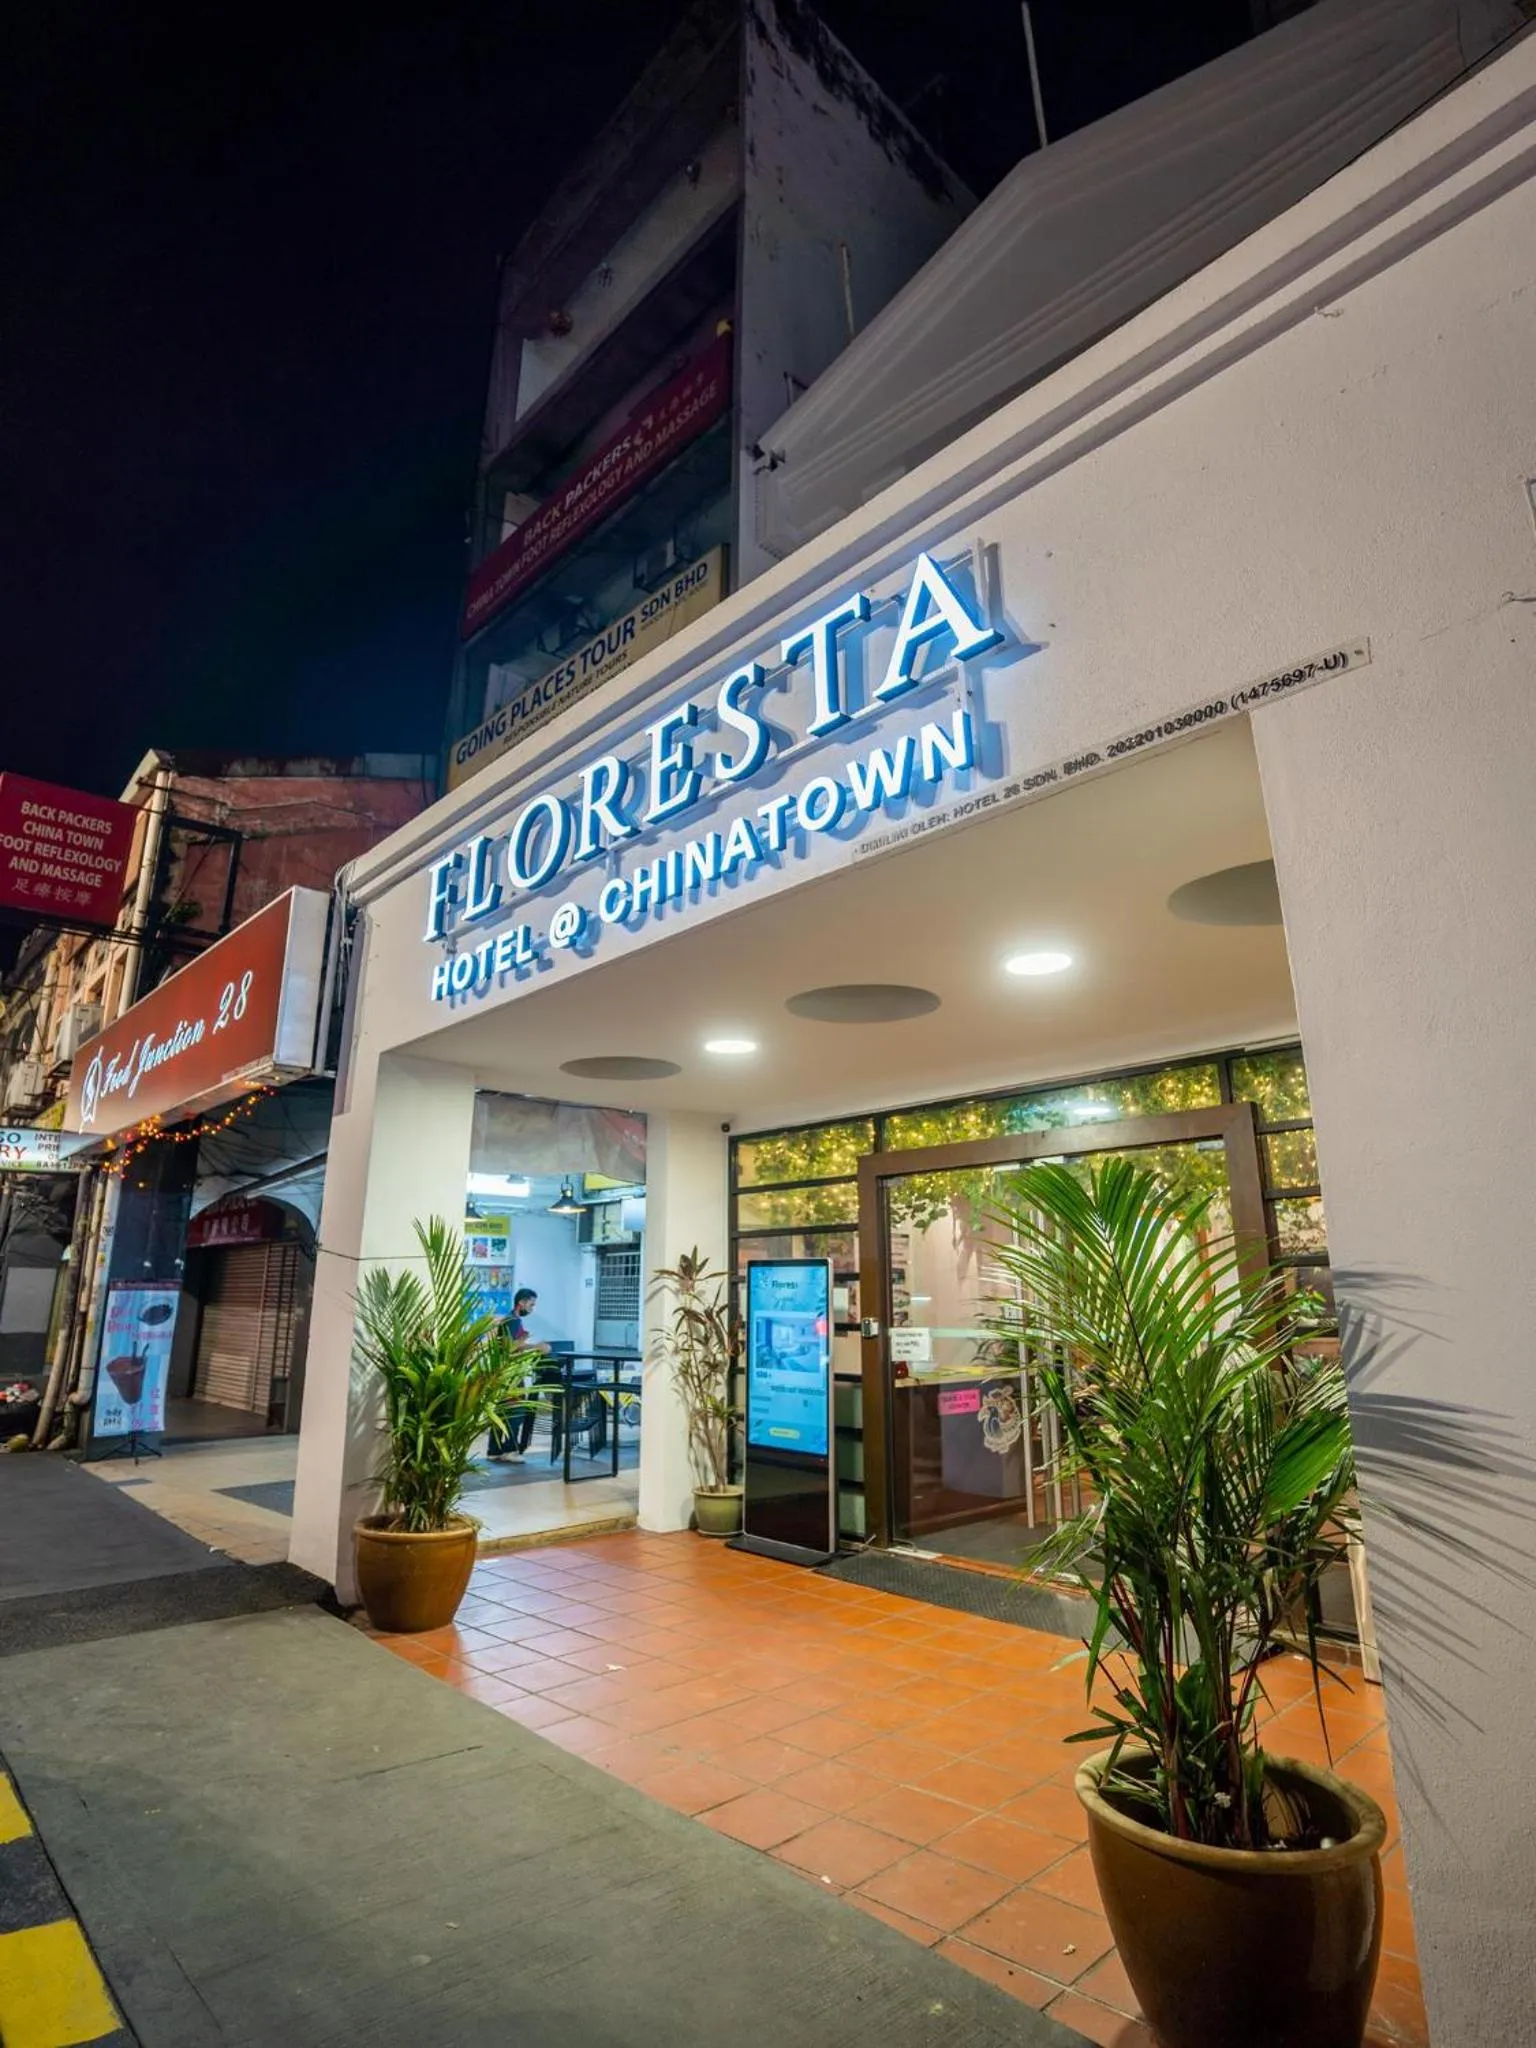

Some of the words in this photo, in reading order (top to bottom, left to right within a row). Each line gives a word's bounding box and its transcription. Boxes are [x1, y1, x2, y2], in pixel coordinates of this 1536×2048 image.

[523, 501, 563, 545] BACK
[564, 438, 632, 511] PACKERS
[548, 468, 624, 546] REFLEXOLOGY
[624, 440, 654, 475] AND
[654, 380, 719, 448] MASSAGE
[457, 714, 508, 765] GOING
[510, 658, 578, 726] PLACES
[580, 616, 636, 674] TOUR
[641, 588, 671, 622] SDN
[675, 562, 708, 599] BHD
[423, 552, 1004, 943] FLORESTA
[21, 801, 57, 821] BACK
[58, 810, 113, 835] PACKERS
[23, 821, 64, 842] CHINA
[66, 830, 104, 851] TOWN
[33, 842, 122, 873] REFLEXOLOGY
[432, 925, 538, 1003] HOTEL
[549, 901, 587, 949] @
[600, 710, 976, 926] CHINATOWN
[910, 813, 950, 834] OLEH:
[953, 793, 1000, 817] HOTEL
[8, 856, 39, 873] AND
[40, 862, 104, 888] MASSAGE
[101, 1040, 140, 1097] Food
[128, 1019, 206, 1098] Junction
[212, 970, 254, 1034] 28
